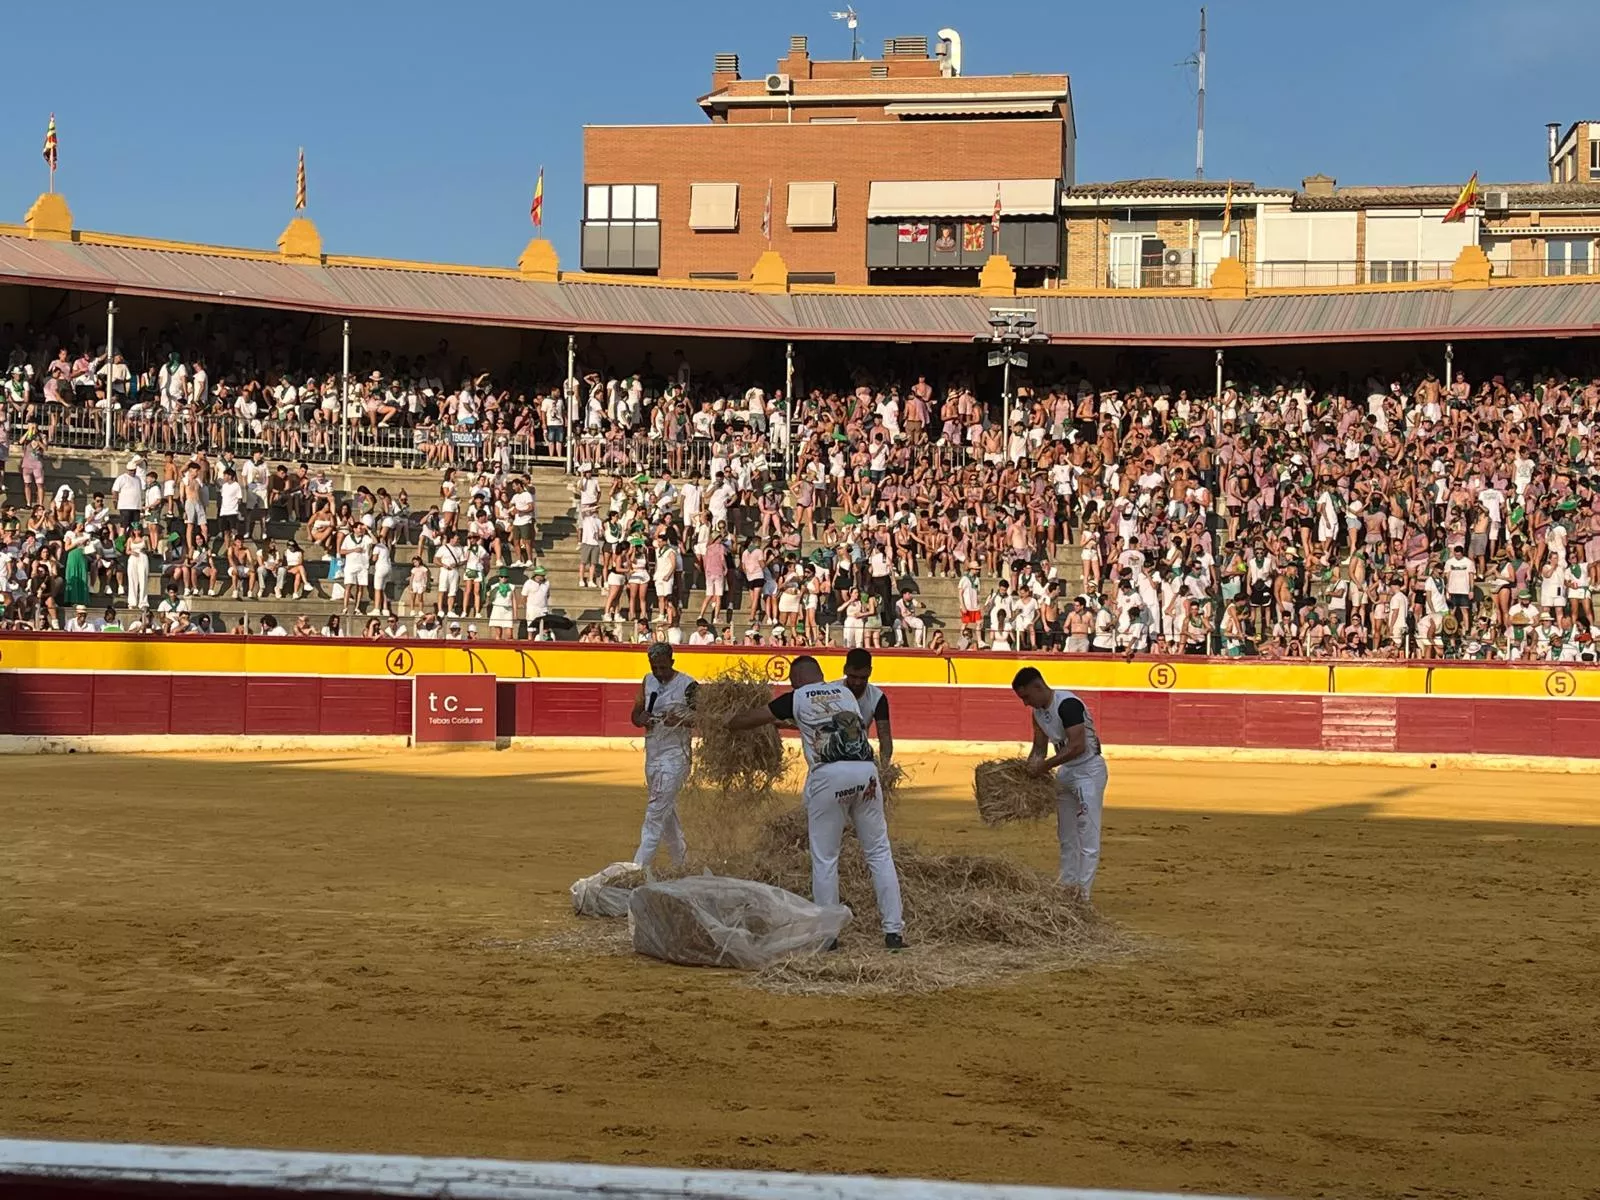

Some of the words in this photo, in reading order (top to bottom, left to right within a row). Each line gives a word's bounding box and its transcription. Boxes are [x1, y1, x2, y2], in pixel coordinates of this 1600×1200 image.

[393, 652, 404, 669] 4
[774, 661, 785, 678] 5
[1157, 668, 1168, 685] 5
[805, 689, 831, 698] TOROS
[1555, 676, 1567, 694] 5
[429, 717, 451, 725] Tebas
